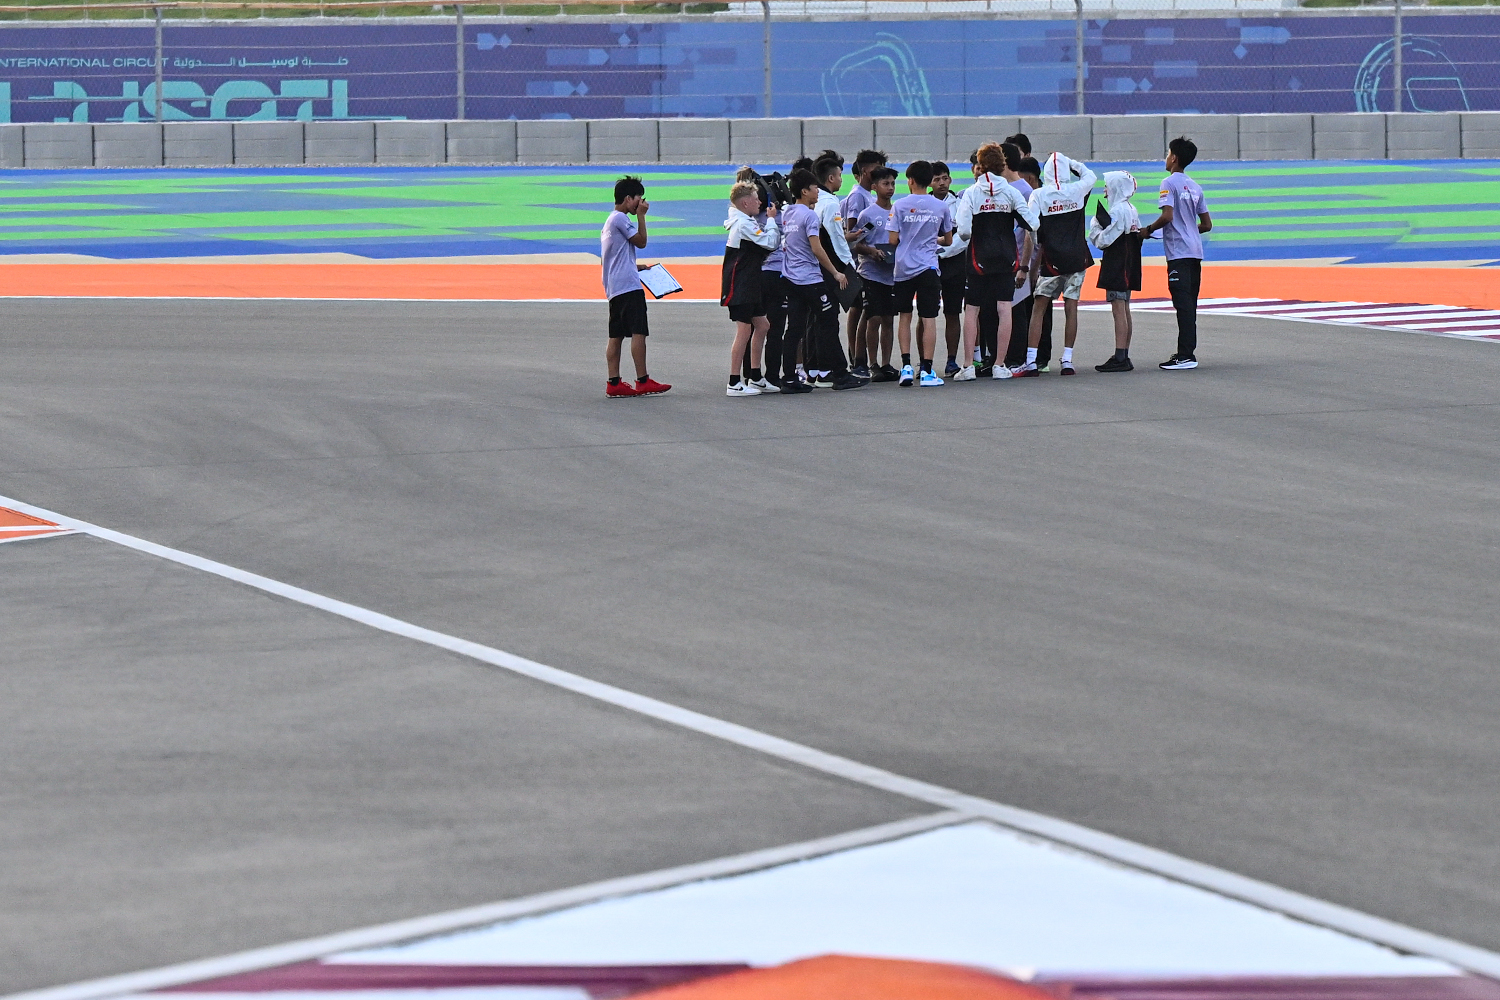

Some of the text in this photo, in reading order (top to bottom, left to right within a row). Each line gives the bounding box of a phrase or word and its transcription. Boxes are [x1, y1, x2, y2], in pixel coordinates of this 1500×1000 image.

[0, 57, 110, 68] NTERNATIONAL
[980, 203, 996, 212] ASIA
[1047, 204, 1064, 213] ASIA
